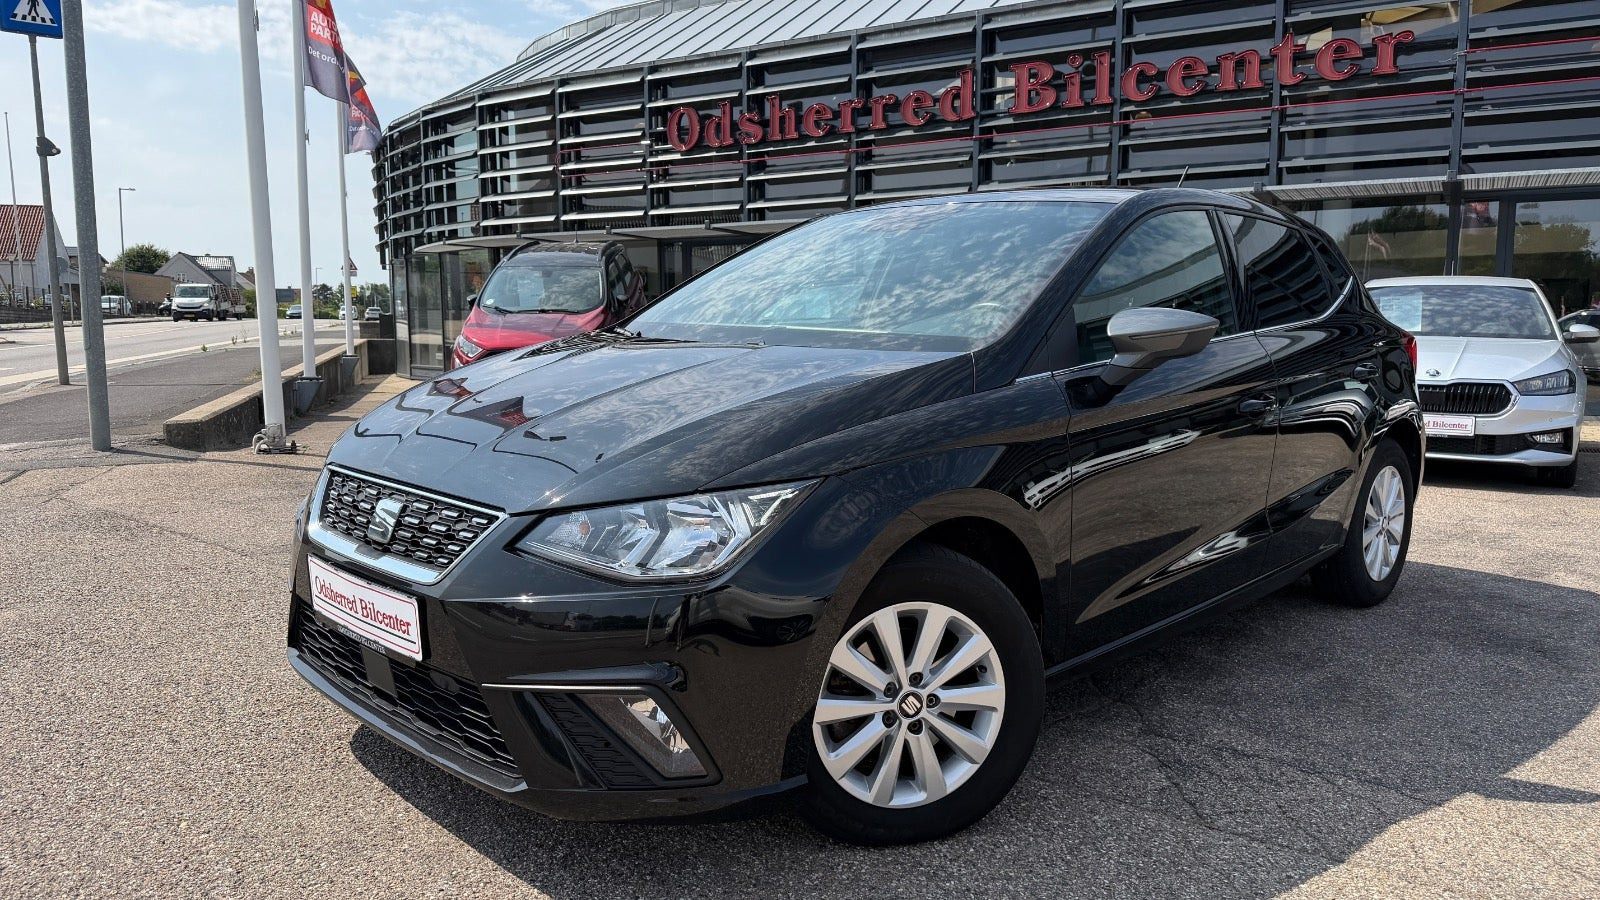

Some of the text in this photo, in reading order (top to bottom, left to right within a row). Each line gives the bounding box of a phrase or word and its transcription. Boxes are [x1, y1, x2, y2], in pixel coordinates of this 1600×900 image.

[310, 11, 338, 32] AUTO
[308, 46, 320, 58] Det
[666, 30, 1415, 151] Odsherred Bilcenter
[1432, 420, 1469, 429] Bilcenter
[315, 575, 359, 614] Odsherred
[359, 597, 411, 636] Bilcenter
